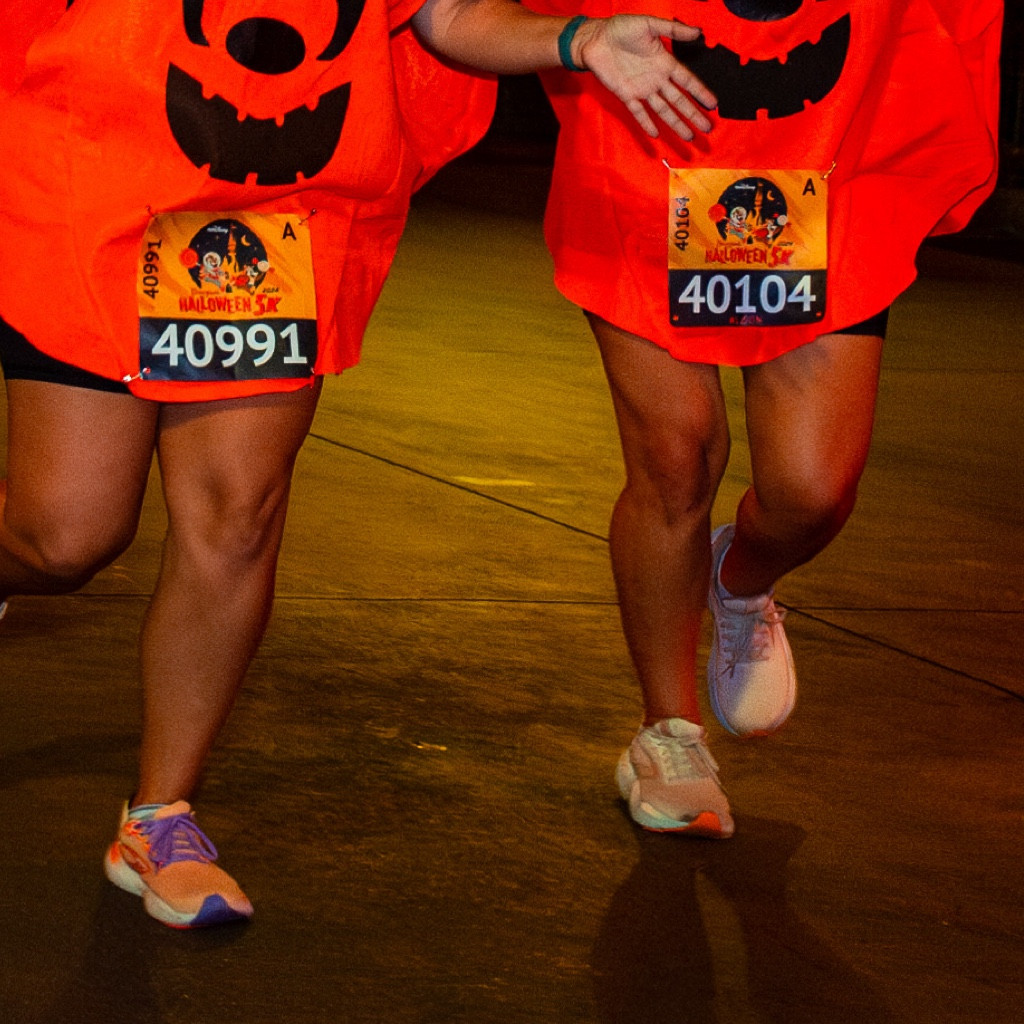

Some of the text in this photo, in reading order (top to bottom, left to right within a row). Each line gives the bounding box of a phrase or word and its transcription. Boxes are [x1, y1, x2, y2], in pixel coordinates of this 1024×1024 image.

[802, 178, 816, 196] A
[282, 222, 296, 240] A
[704, 244, 794, 268] HALLOWEEN 5K
[143, 239, 162, 299] 40991
[179, 294, 281, 316] HALLOWEEN 5K
[678, 275, 816, 314] 40104
[151, 323, 307, 367] 40991
